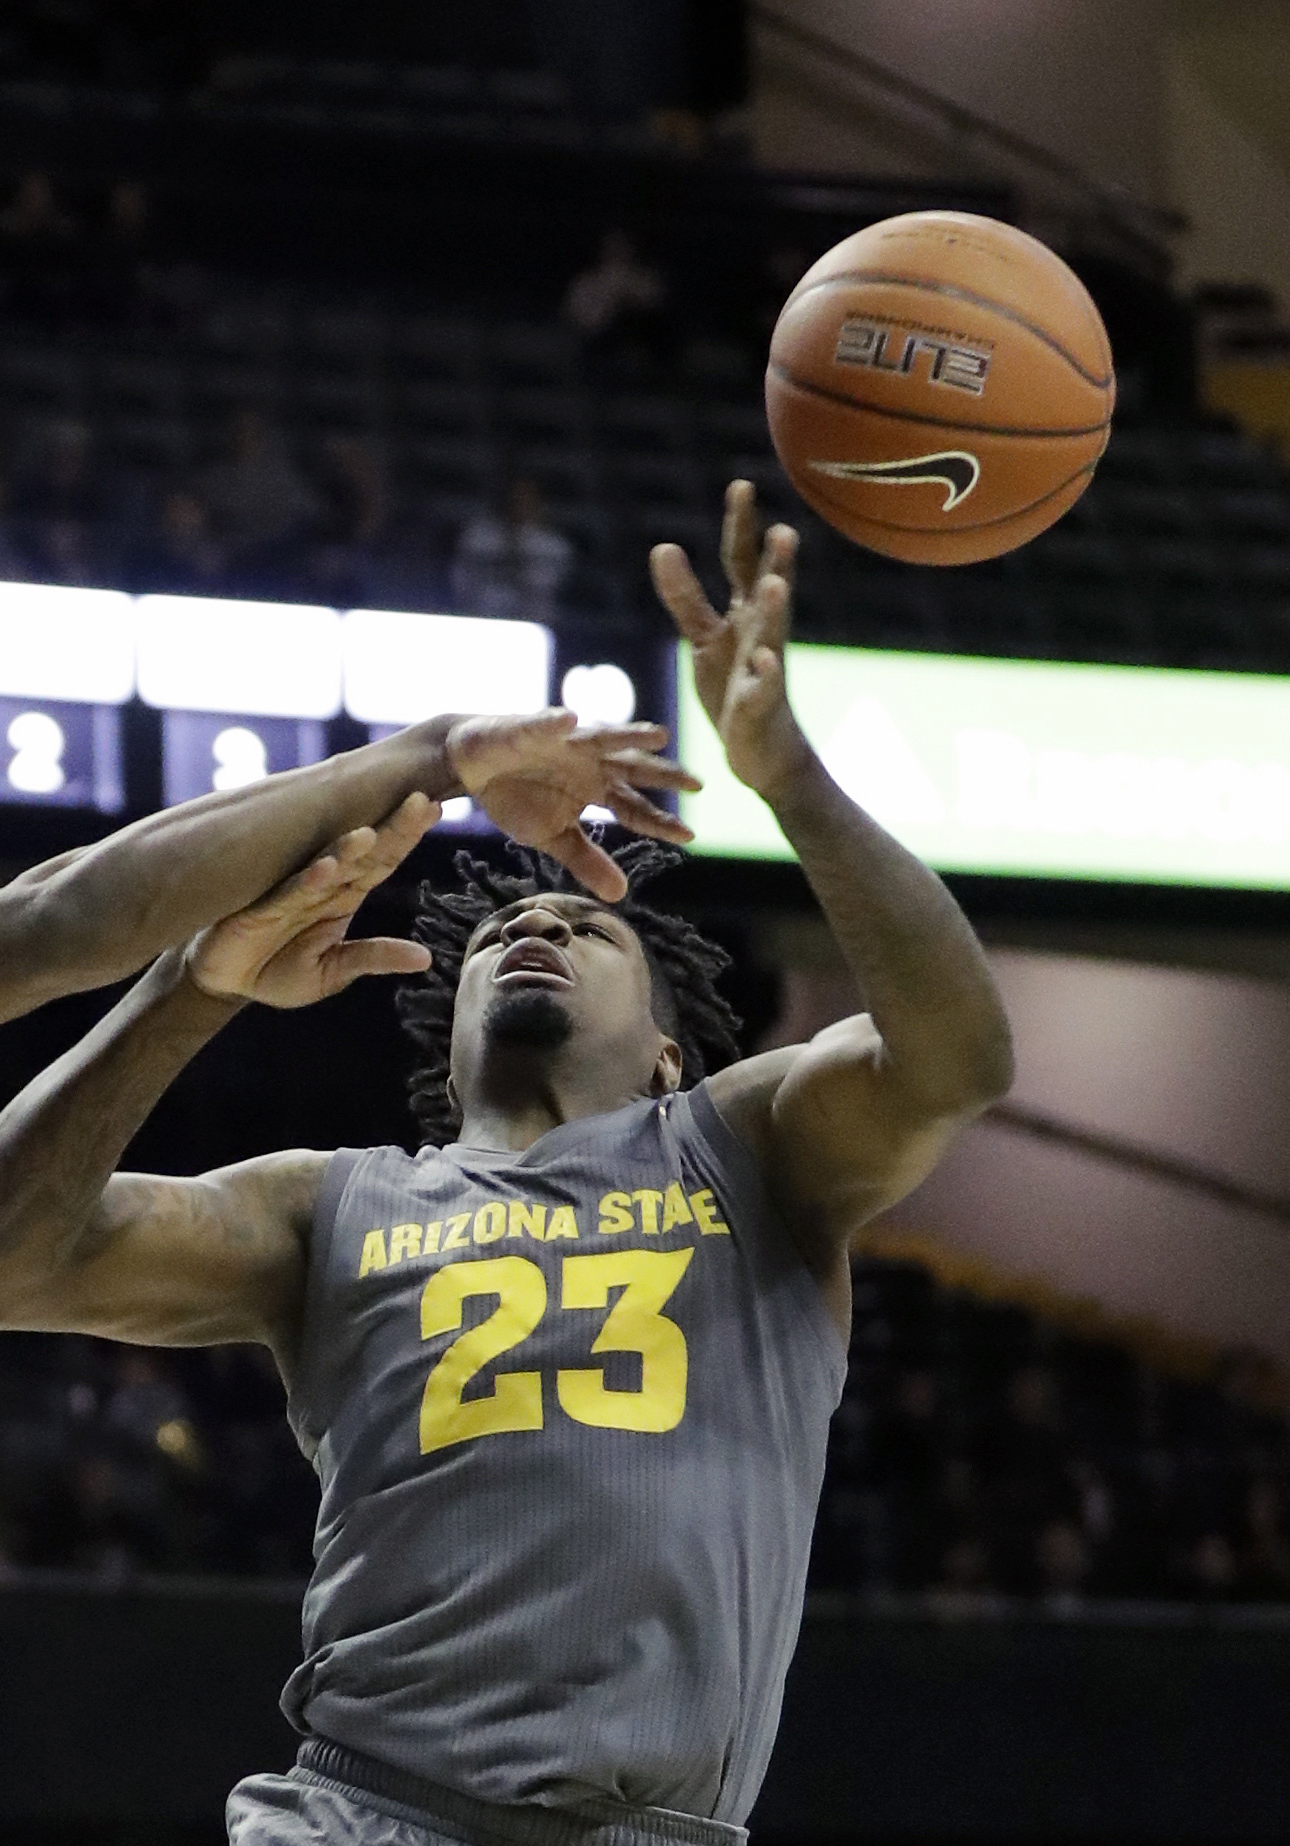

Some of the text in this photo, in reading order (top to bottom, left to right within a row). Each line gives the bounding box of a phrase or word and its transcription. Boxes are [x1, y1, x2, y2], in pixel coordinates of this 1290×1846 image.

[834, 321, 992, 397] ELITE
[357, 1200, 580, 1280] ARIZONA
[419, 1246, 695, 1456] 23
